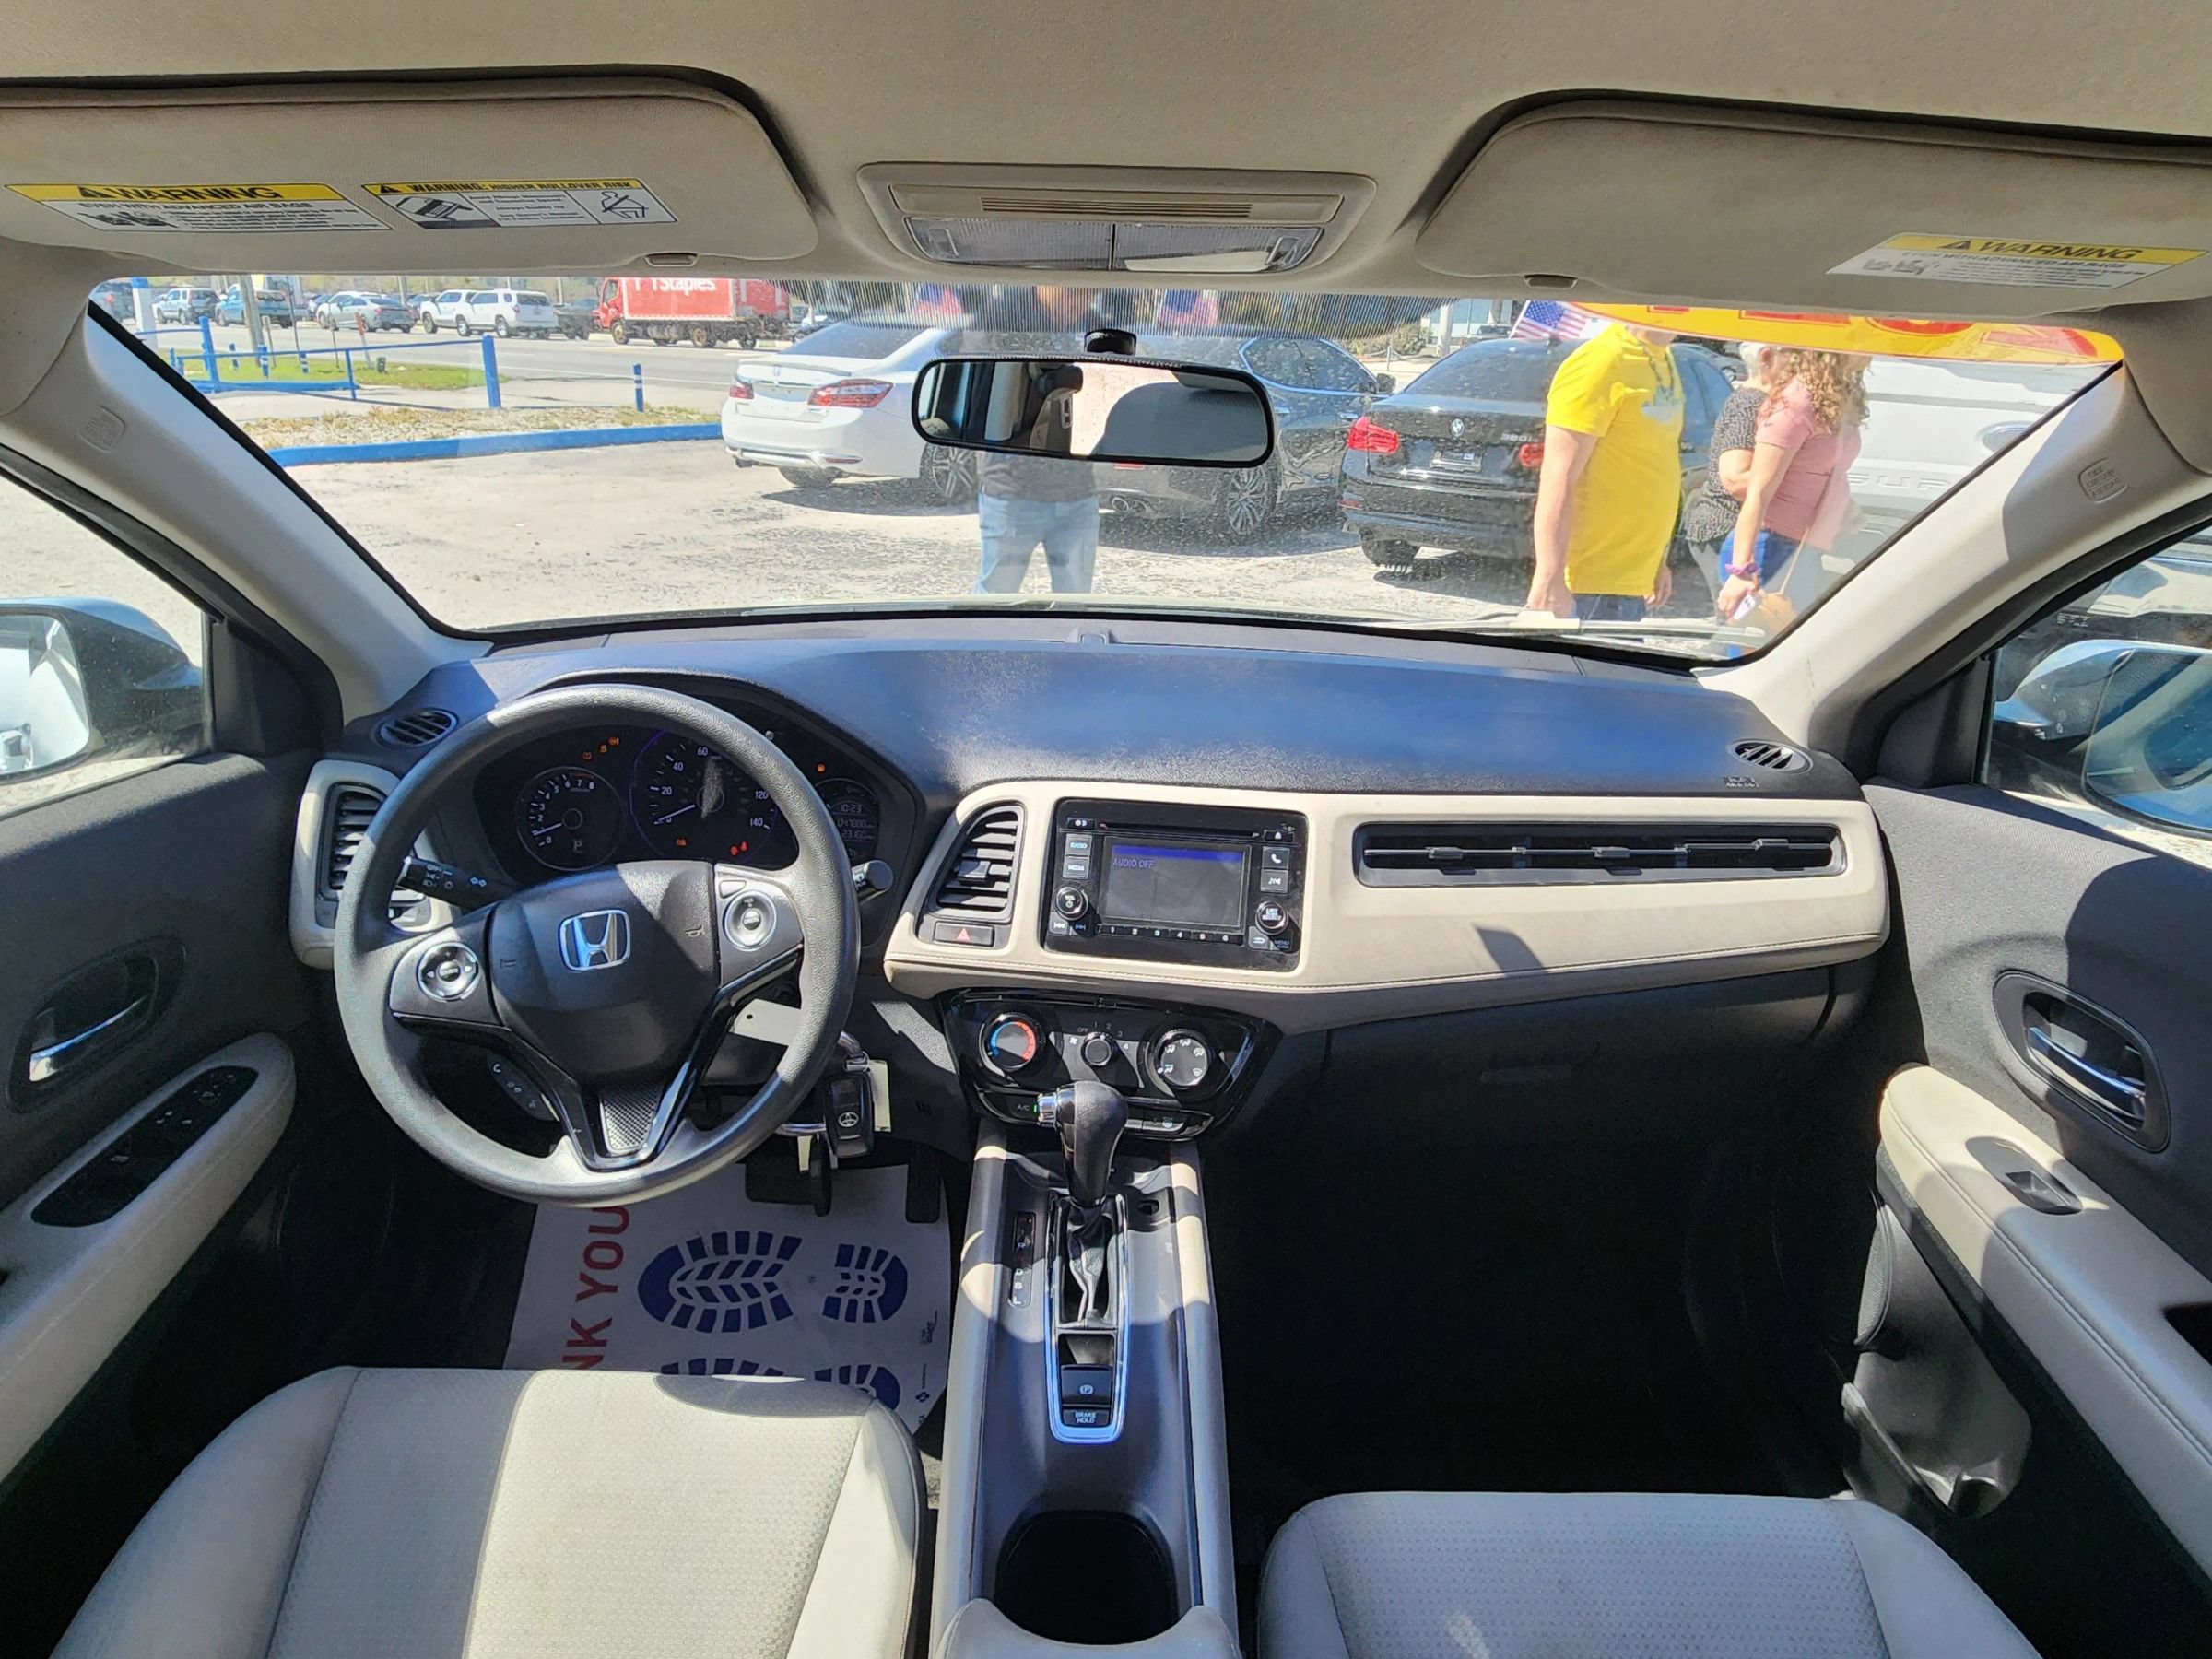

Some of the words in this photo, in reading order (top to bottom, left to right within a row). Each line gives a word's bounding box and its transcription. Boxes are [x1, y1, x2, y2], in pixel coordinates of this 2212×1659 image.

[407, 183, 488, 193] WARNING:
[104, 187, 283, 200] WARNING
[1979, 241, 2145, 259] WARNING
[657, 278, 717, 296] Staples
[697, 747, 708, 756] 60
[673, 762, 683, 771] 40
[564, 780, 571, 788] 6
[588, 782, 594, 790] 8
[661, 786, 673, 795] 20
[755, 791, 768, 800] 120
[750, 818, 763, 827] 140
[546, 835, 552, 844] 0
[1112, 858, 1136, 867] AUDIO
[1139, 859, 1155, 868] OFF
[575, 1206, 629, 1302] YOU
[1013, 1296, 1021, 1304] L
